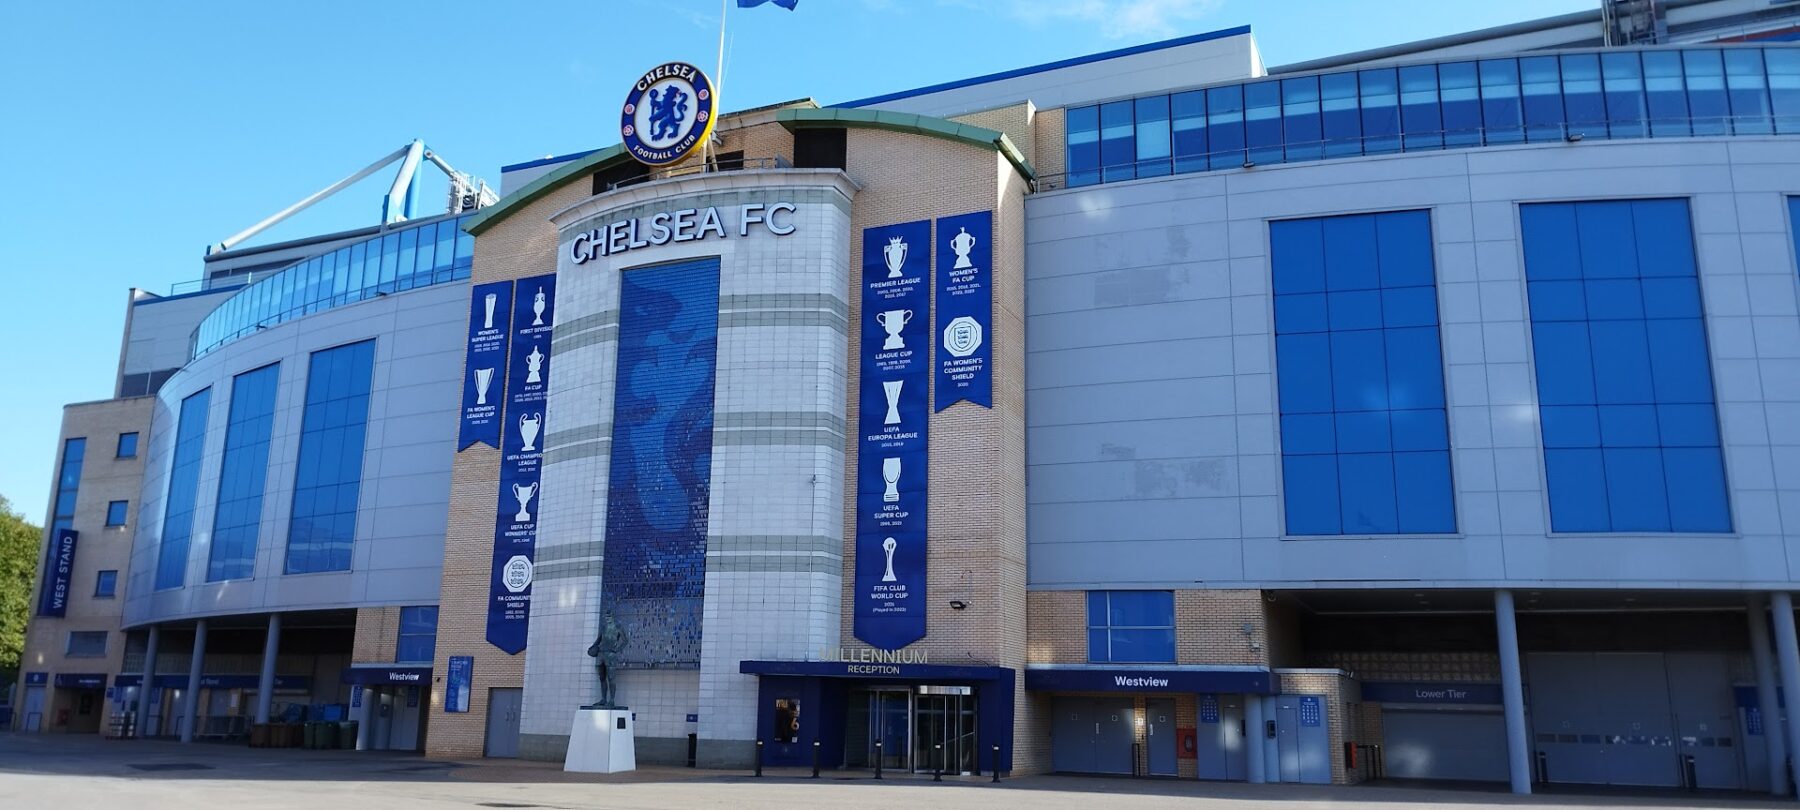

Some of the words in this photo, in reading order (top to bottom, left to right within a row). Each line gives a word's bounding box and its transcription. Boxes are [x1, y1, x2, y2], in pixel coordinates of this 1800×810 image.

[637, 64, 696, 91] CHELSEA
[633, 145, 672, 160] FOOTBALL
[675, 134, 696, 153] CLUB
[570, 206, 726, 265] CHELSEA
[740, 202, 796, 237] FC
[949, 267, 978, 277] WOMEN'S
[870, 280, 897, 289] PREMIER
[897, 277, 921, 286] LEAGUE
[534, 325, 553, 333] DIVISIO
[875, 352, 899, 360] LEAGUE
[952, 358, 983, 366] WOMEN'S
[943, 365, 983, 374] COMMUNITY
[893, 432, 918, 440] LEAGUE
[58, 536, 73, 573] STAND
[52, 577, 66, 609] WEST
[847, 664, 900, 674] RECEPTION
[389, 672, 420, 681] Westview
[1114, 675, 1169, 687] Westview
[1415, 689, 1446, 698] Lower
[1447, 689, 1467, 698] Tier
